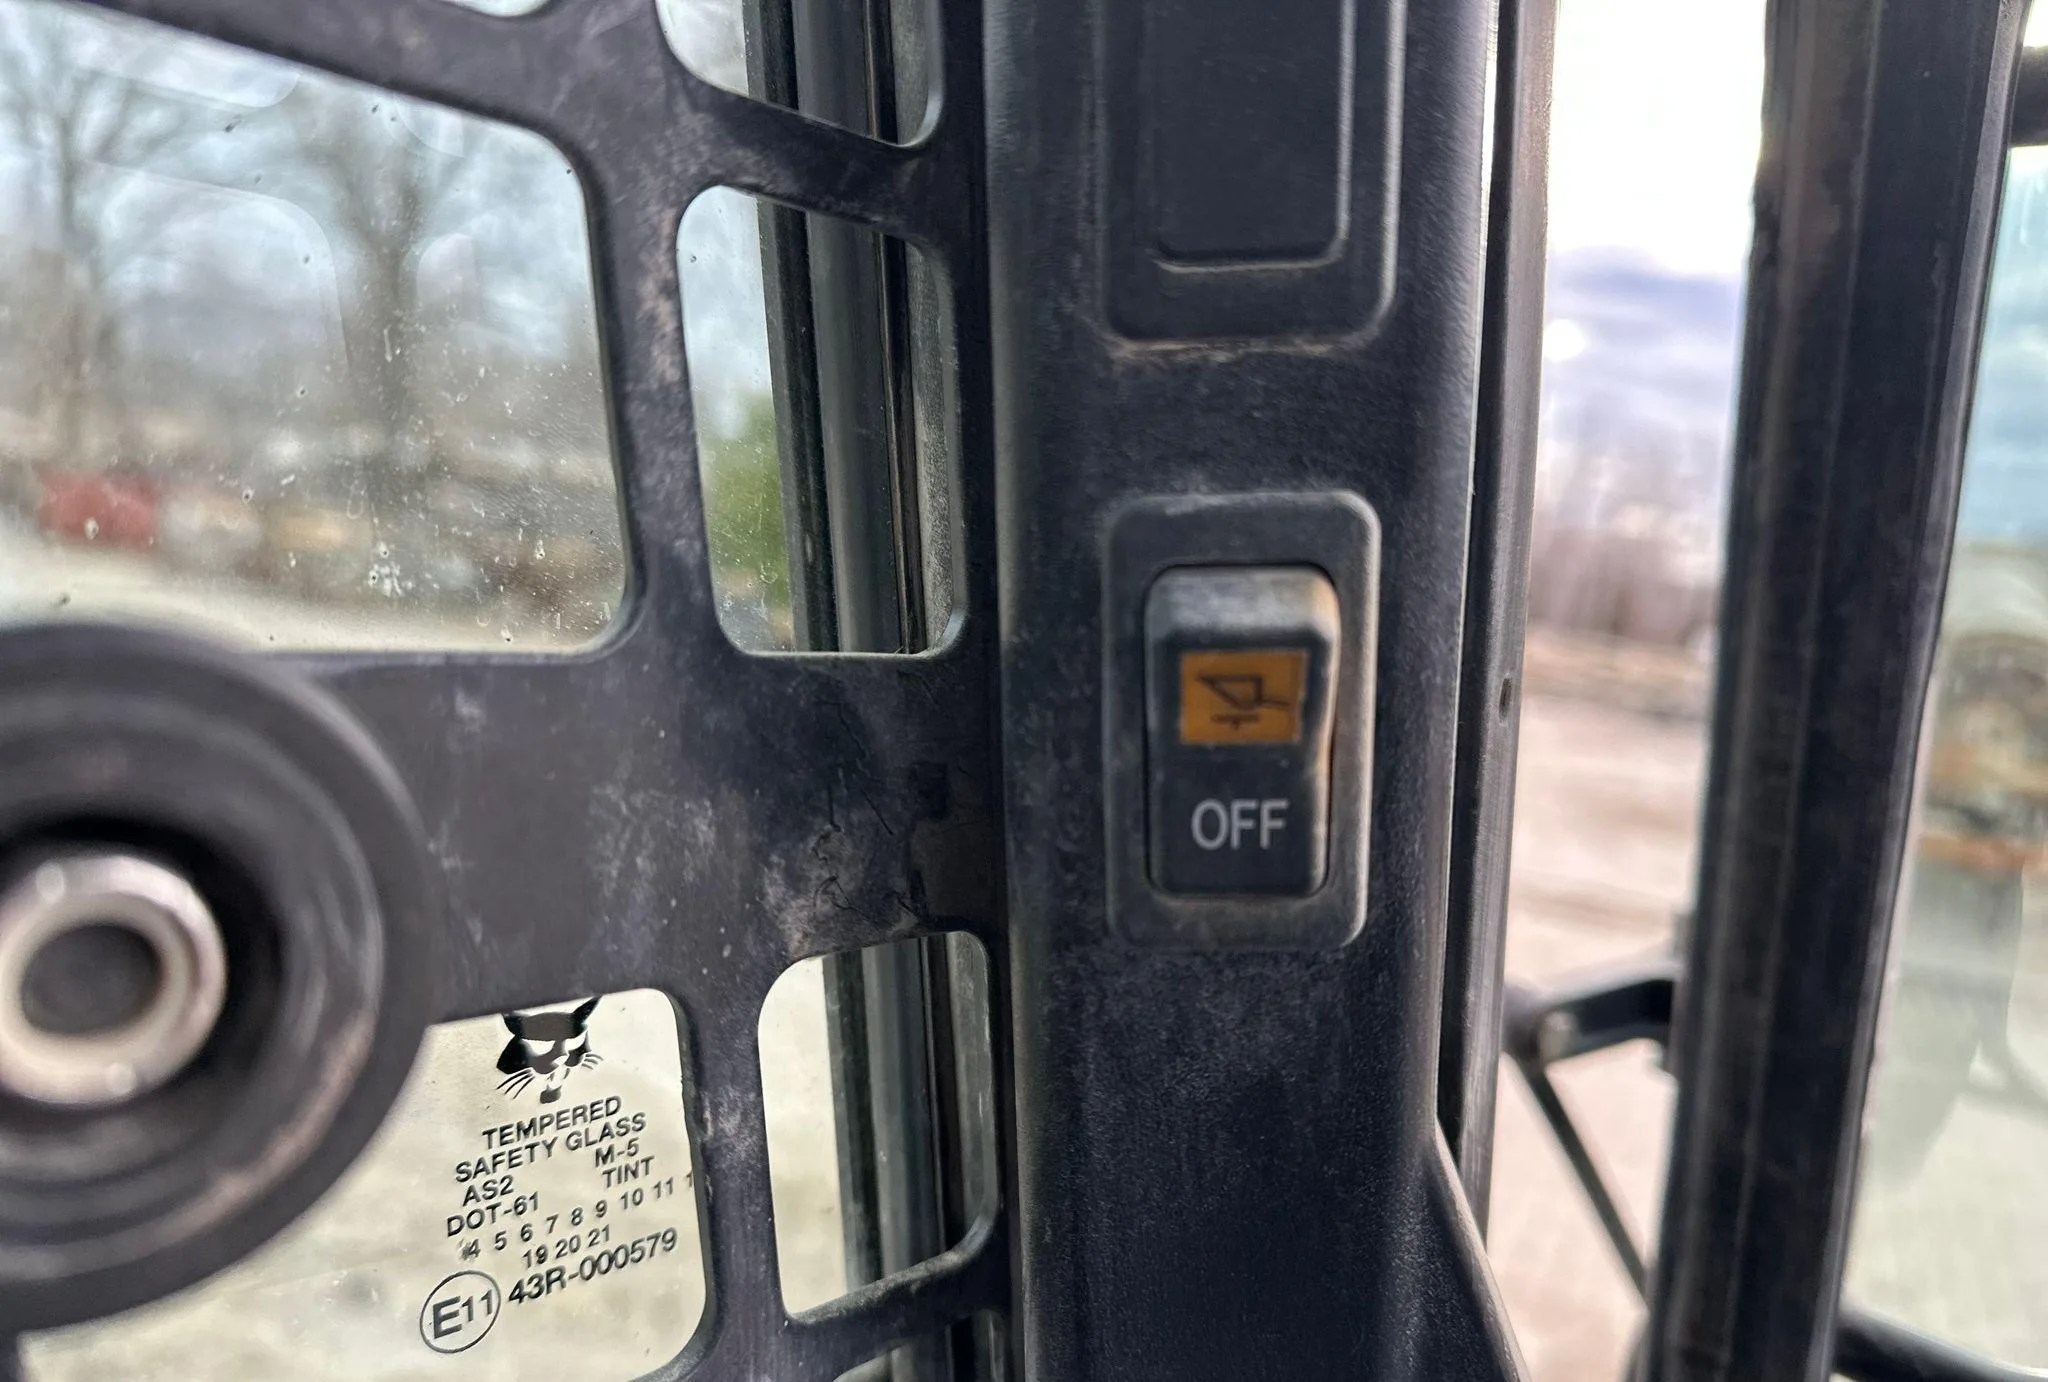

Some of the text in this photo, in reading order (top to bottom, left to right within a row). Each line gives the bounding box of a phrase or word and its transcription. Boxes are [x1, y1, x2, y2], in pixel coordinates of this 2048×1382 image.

[1191, 799, 1290, 851] OFF
[455, 1112, 647, 1183] SAFETY GLASS
[482, 1096, 622, 1150] TEMPERED
[595, 1137, 640, 1168] M-5
[601, 1155, 655, 1188] TINT
[447, 1191, 539, 1237] DOT-61
[462, 1174, 515, 1206] AS2
[494, 1230, 507, 1251] 5
[520, 1223, 533, 1243] 6
[546, 1214, 559, 1234] 7
[571, 1206, 584, 1226] 8
[595, 1199, 608, 1218] 9
[620, 1187, 644, 1211] 10
[653, 1177, 673, 1199] 11
[507, 1227, 678, 1304] 43R-000579
[523, 1224, 610, 1269] 19 20 21
[432, 1289, 494, 1340] E11
